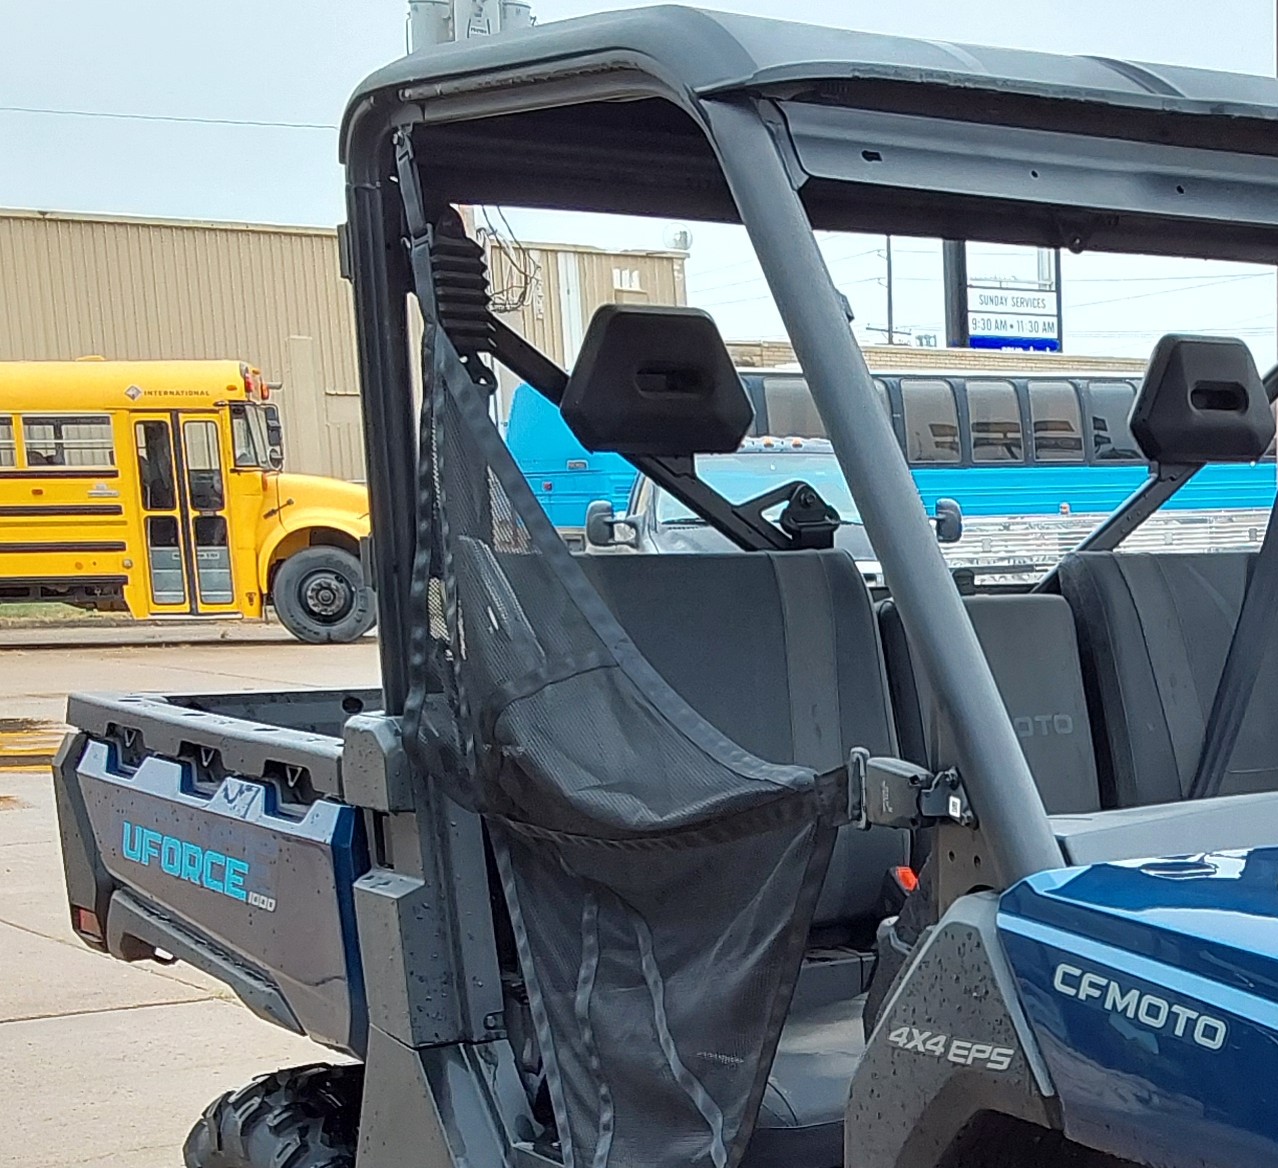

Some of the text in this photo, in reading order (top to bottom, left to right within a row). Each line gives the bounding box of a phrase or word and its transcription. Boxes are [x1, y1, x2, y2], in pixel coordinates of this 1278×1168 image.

[978, 294, 1047, 309] SUNDAY SERVICES
[971, 317, 992, 331] 9:30
[994, 319, 1008, 331] AM
[1041, 321, 1055, 333] AM
[122, 820, 250, 902] UFORCE
[248, 891, 277, 912] 1000
[1053, 962, 1228, 1051] CFMOTO
[888, 1026, 1016, 1071] 4X4 EPS
